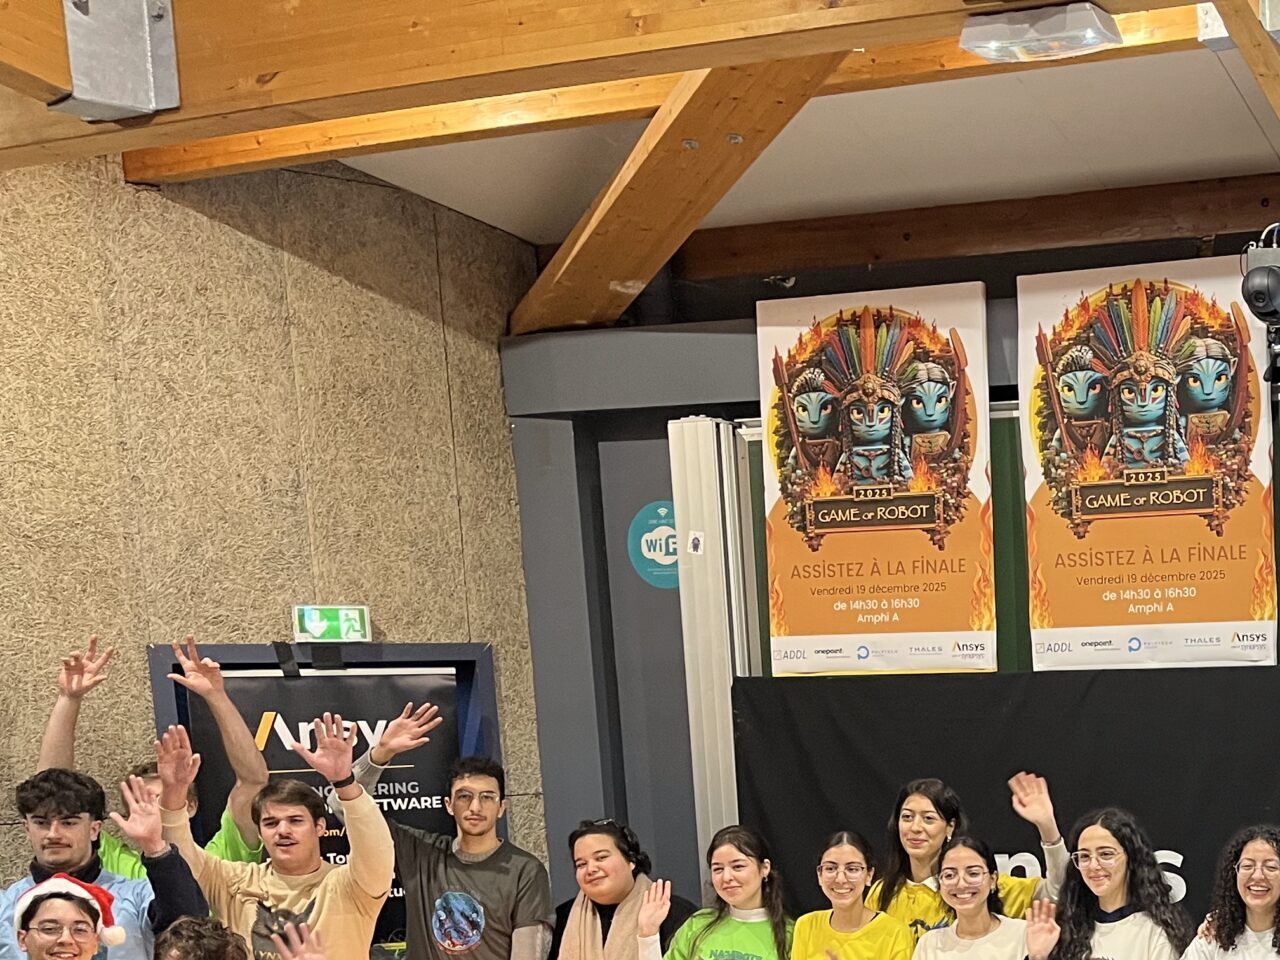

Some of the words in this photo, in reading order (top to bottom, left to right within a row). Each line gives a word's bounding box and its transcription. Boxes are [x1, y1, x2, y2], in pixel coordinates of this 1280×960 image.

[1130, 472, 1161, 482] 2025
[859, 489, 888, 498] 2025
[1085, 493, 1131, 508] GAME
[1149, 488, 1208, 504] ROBOT
[818, 509, 861, 522] GAME
[877, 505, 930, 519] ROBOT
[1142, 545, 1154, 565] À
[1160, 548, 1181, 564] LA
[870, 557, 881, 577] À
[887, 561, 906, 576] LA
[1076, 574, 1124, 586] Vendredi
[1127, 574, 1138, 584] 19
[1140, 572, 1196, 583] décembre
[1199, 569, 1226, 581] 2025
[809, 586, 854, 596] Vendredi
[856, 585, 866, 595] 19
[868, 583, 919, 595] décembre
[922, 581, 947, 592] 2025
[1102, 590, 1117, 601] de
[1119, 588, 1151, 600] 14h30
[1154, 588, 1162, 599] à
[1164, 586, 1197, 598] 16h30
[833, 601, 847, 611] de
[850, 599, 878, 610] 14h30
[881, 599, 888, 609] à
[890, 597, 920, 609] 16h30
[1128, 603, 1164, 615] Amphi
[1166, 603, 1174, 612] A
[857, 612, 890, 625] Amphi
[892, 612, 900, 621] A
[1231, 631, 1267, 642] Ansys
[952, 641, 985, 652] Ansys
[1046, 642, 1073, 653] ADDL
[782, 649, 807, 660] ADDL
